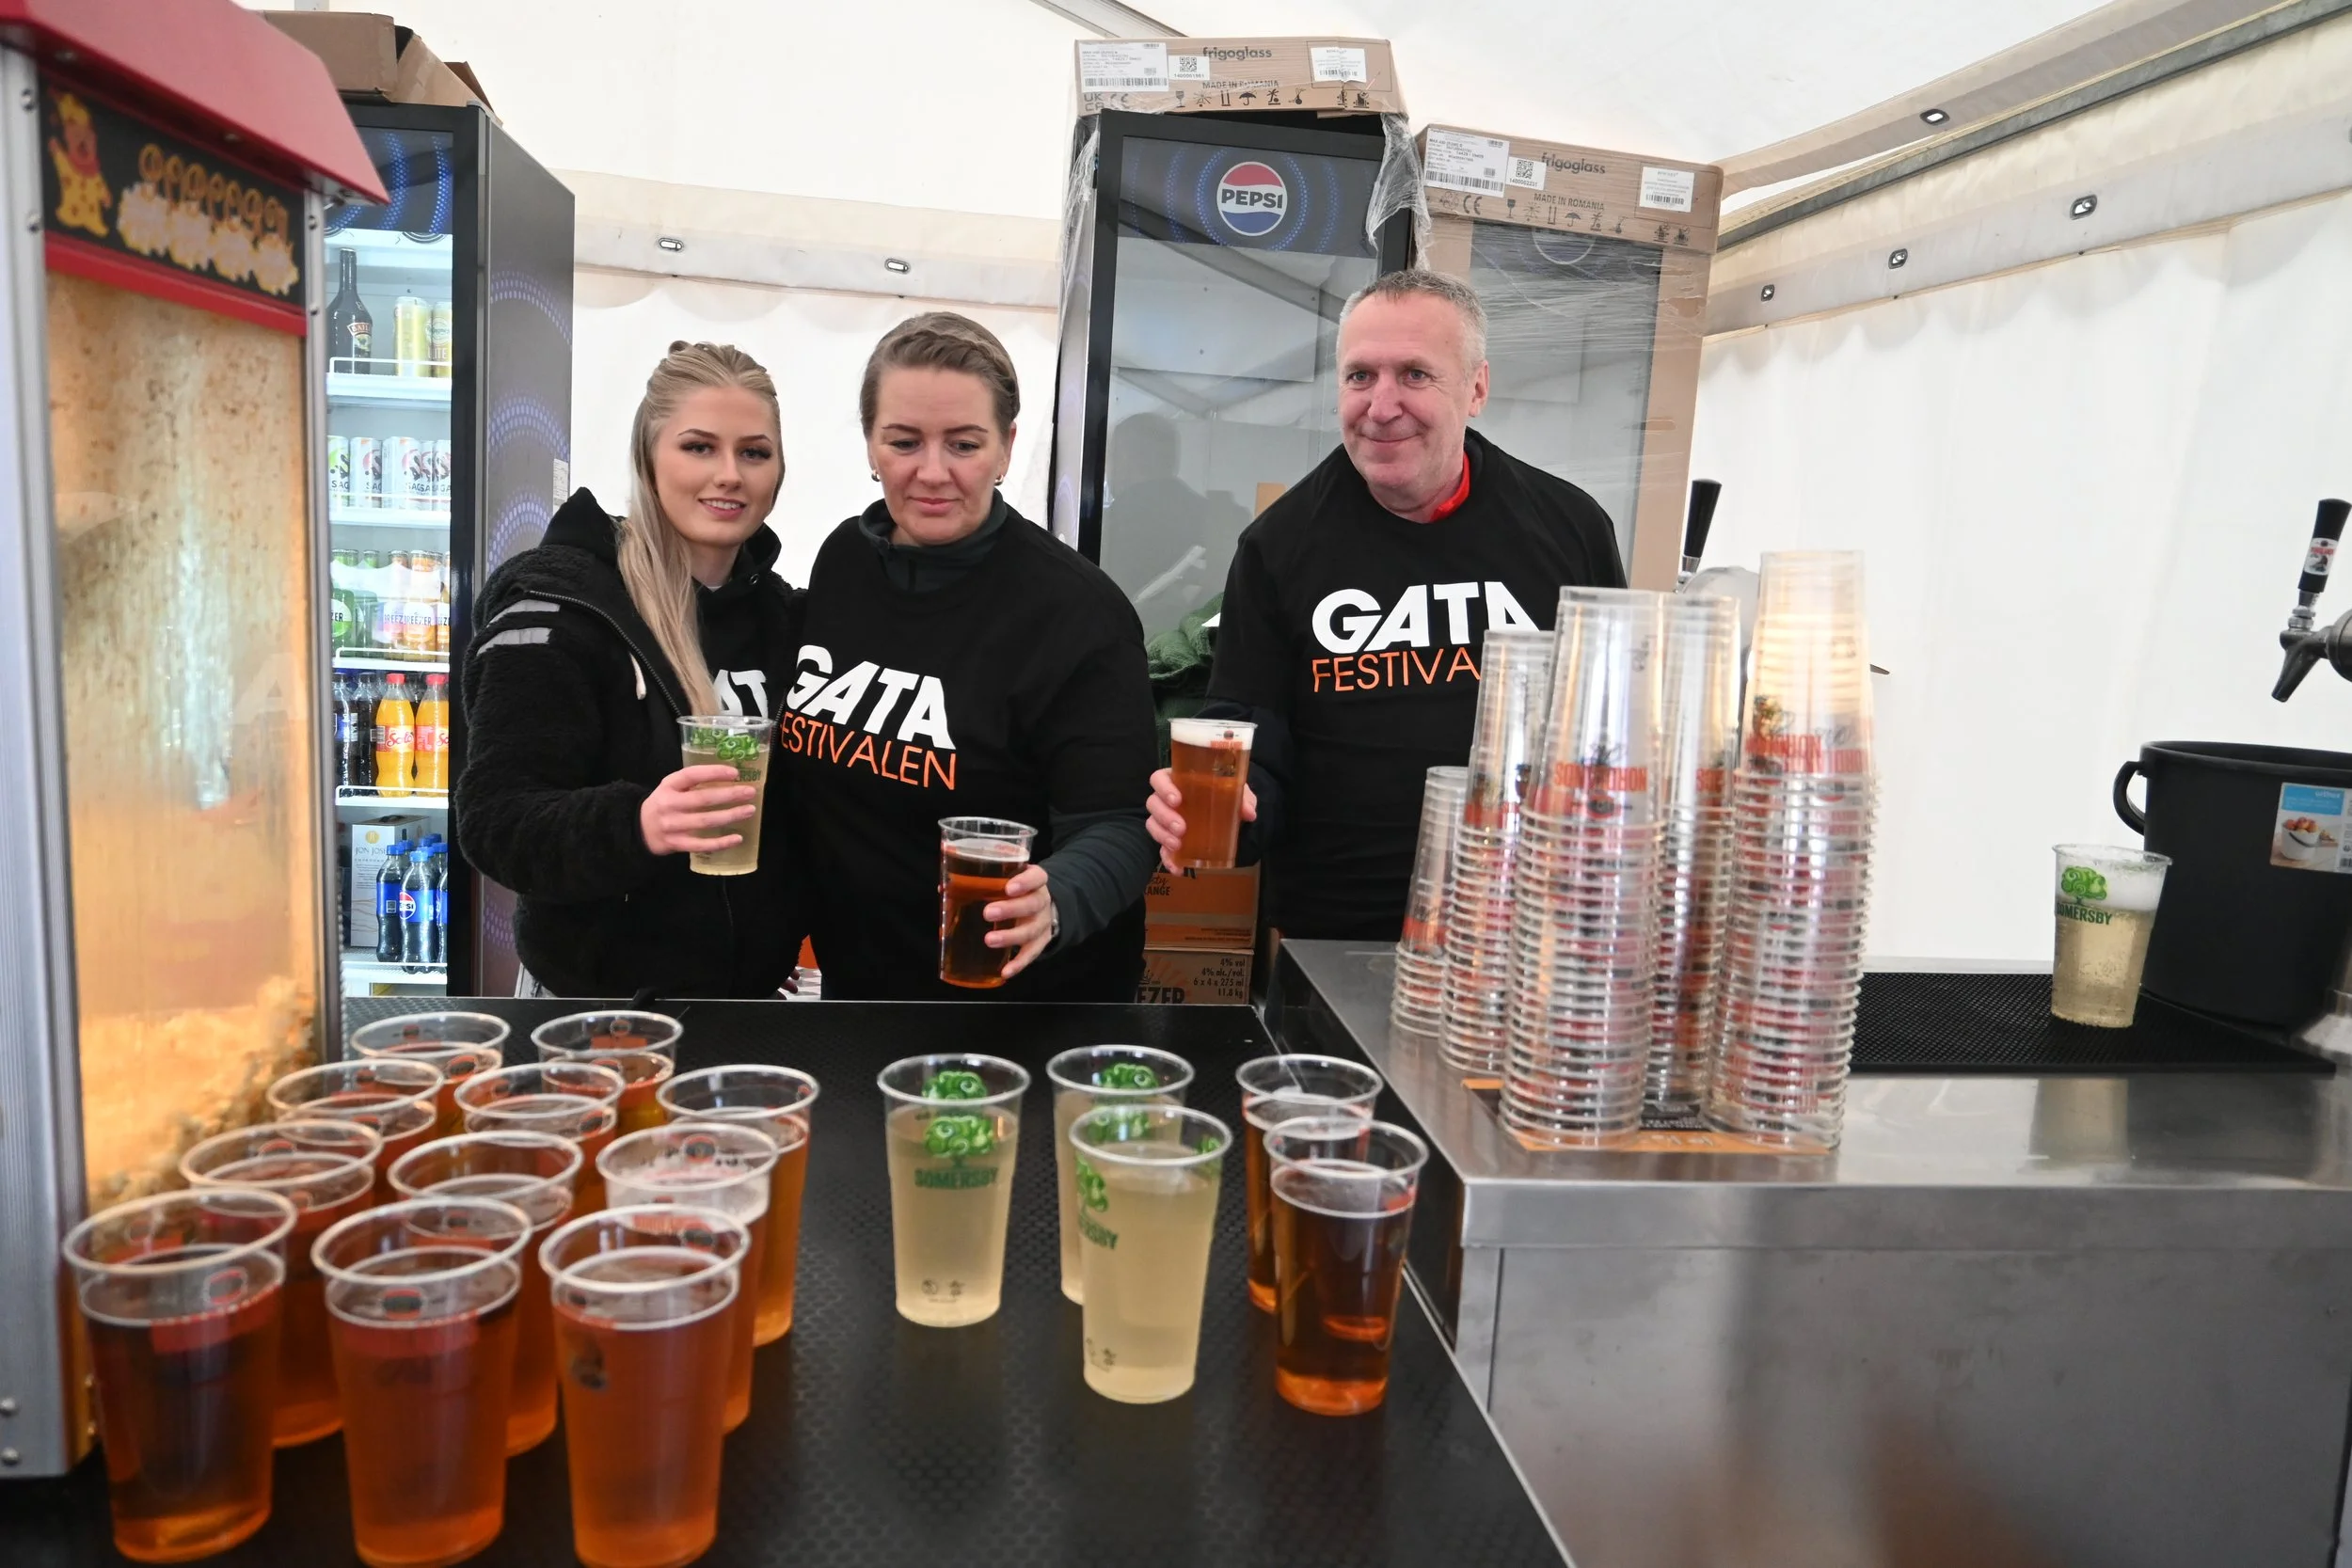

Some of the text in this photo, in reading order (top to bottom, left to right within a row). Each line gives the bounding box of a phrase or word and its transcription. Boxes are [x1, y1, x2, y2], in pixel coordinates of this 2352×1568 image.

[1202, 46, 1272, 60] frigoglass
[1202, 81, 1226, 89] MADE
[1541, 152, 1606, 174] frigoglass
[1221, 188, 1283, 209] PEPSI
[1534, 193, 1605, 211] MADE IN ROMANIA
[1311, 581, 1540, 654] GATA
[1311, 646, 1481, 693] FESTIVA
[713, 669, 769, 720] AT
[787, 644, 957, 750] GATA
[386, 732, 414, 748] Solo
[780, 711, 957, 790] ESTIVALEN
[2056, 902, 2113, 926] SOMERSBY
[1201, 967, 1215, 976] 4%
[1234, 958, 1246, 967] vol
[1193, 977, 1199, 986] 6
[1219, 977, 1234, 987] 275
[1235, 978, 1245, 987] ml
[1234, 988, 1244, 999] kg
